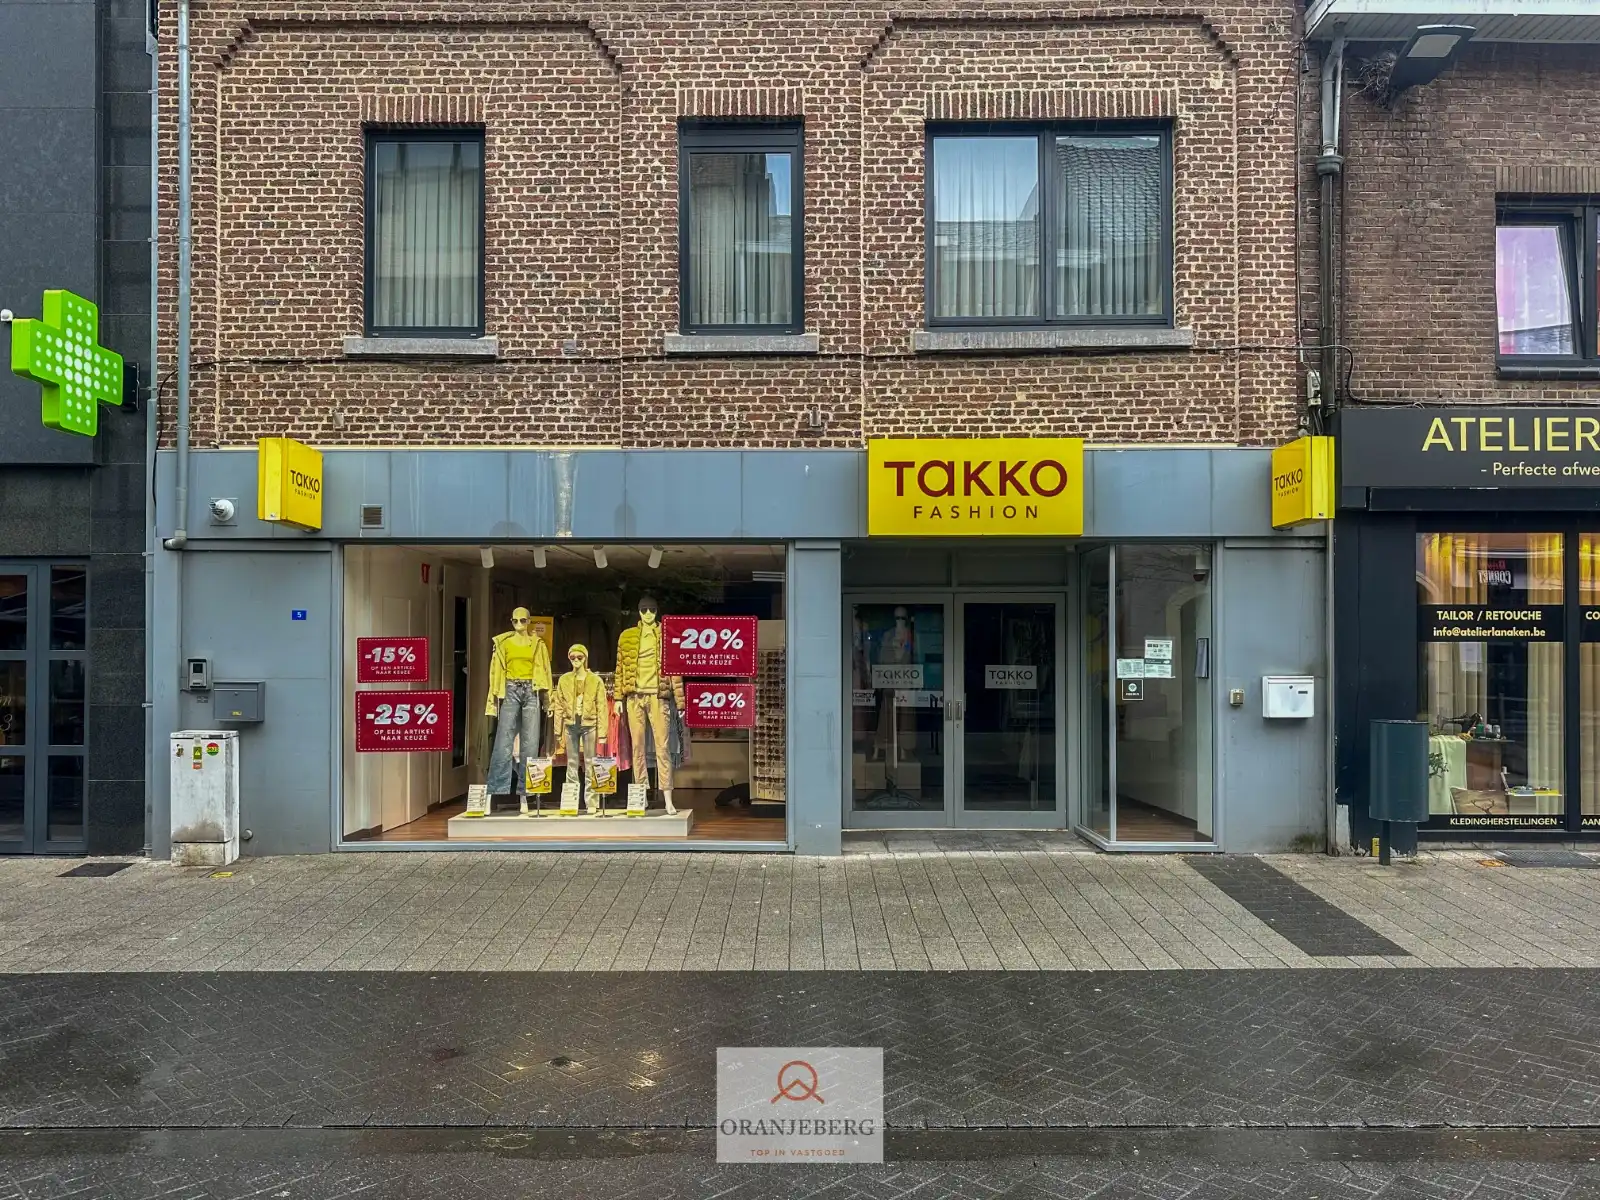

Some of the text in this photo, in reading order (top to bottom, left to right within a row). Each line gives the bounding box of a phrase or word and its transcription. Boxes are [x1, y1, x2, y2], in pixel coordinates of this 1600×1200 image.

[1422, 417, 1600, 451] ATELIER
[1493, 462, 1557, 476] Perfecte
[913, 506, 1038, 519] FASHION
[1437, 611, 1474, 620] TAILOR
[1486, 611, 1542, 620] RETOUCHE
[672, 628, 744, 650] -20%
[1433, 627, 1546, 637] info@atelierlanaken.be
[365, 646, 416, 663] -15%
[693, 692, 745, 709] -20%
[366, 703, 438, 725] -25%
[1450, 818, 1557, 826] KLEDINGHERSTELLINGEN
